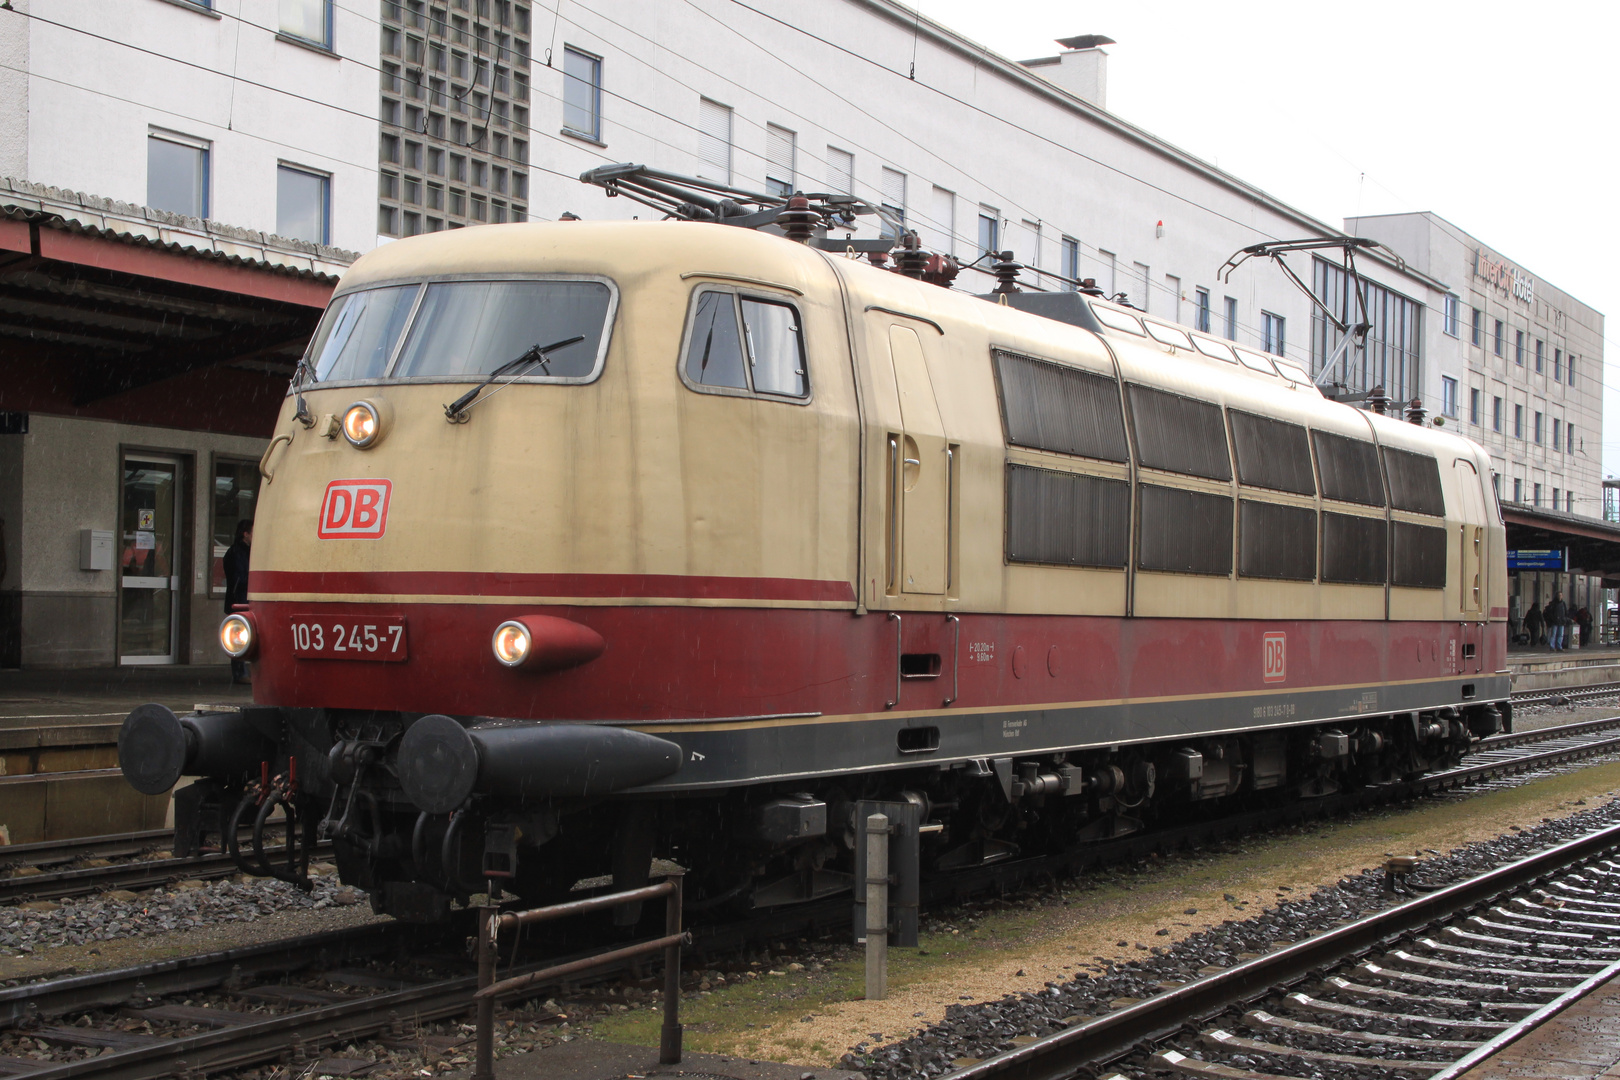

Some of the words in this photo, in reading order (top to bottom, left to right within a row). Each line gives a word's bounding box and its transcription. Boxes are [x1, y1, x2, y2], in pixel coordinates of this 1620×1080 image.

[326, 489, 380, 529] DB
[871, 578, 876, 602] 1
[291, 623, 325, 650] 103
[332, 624, 403, 653] 245-7
[1266, 640, 1284, 674] DB
